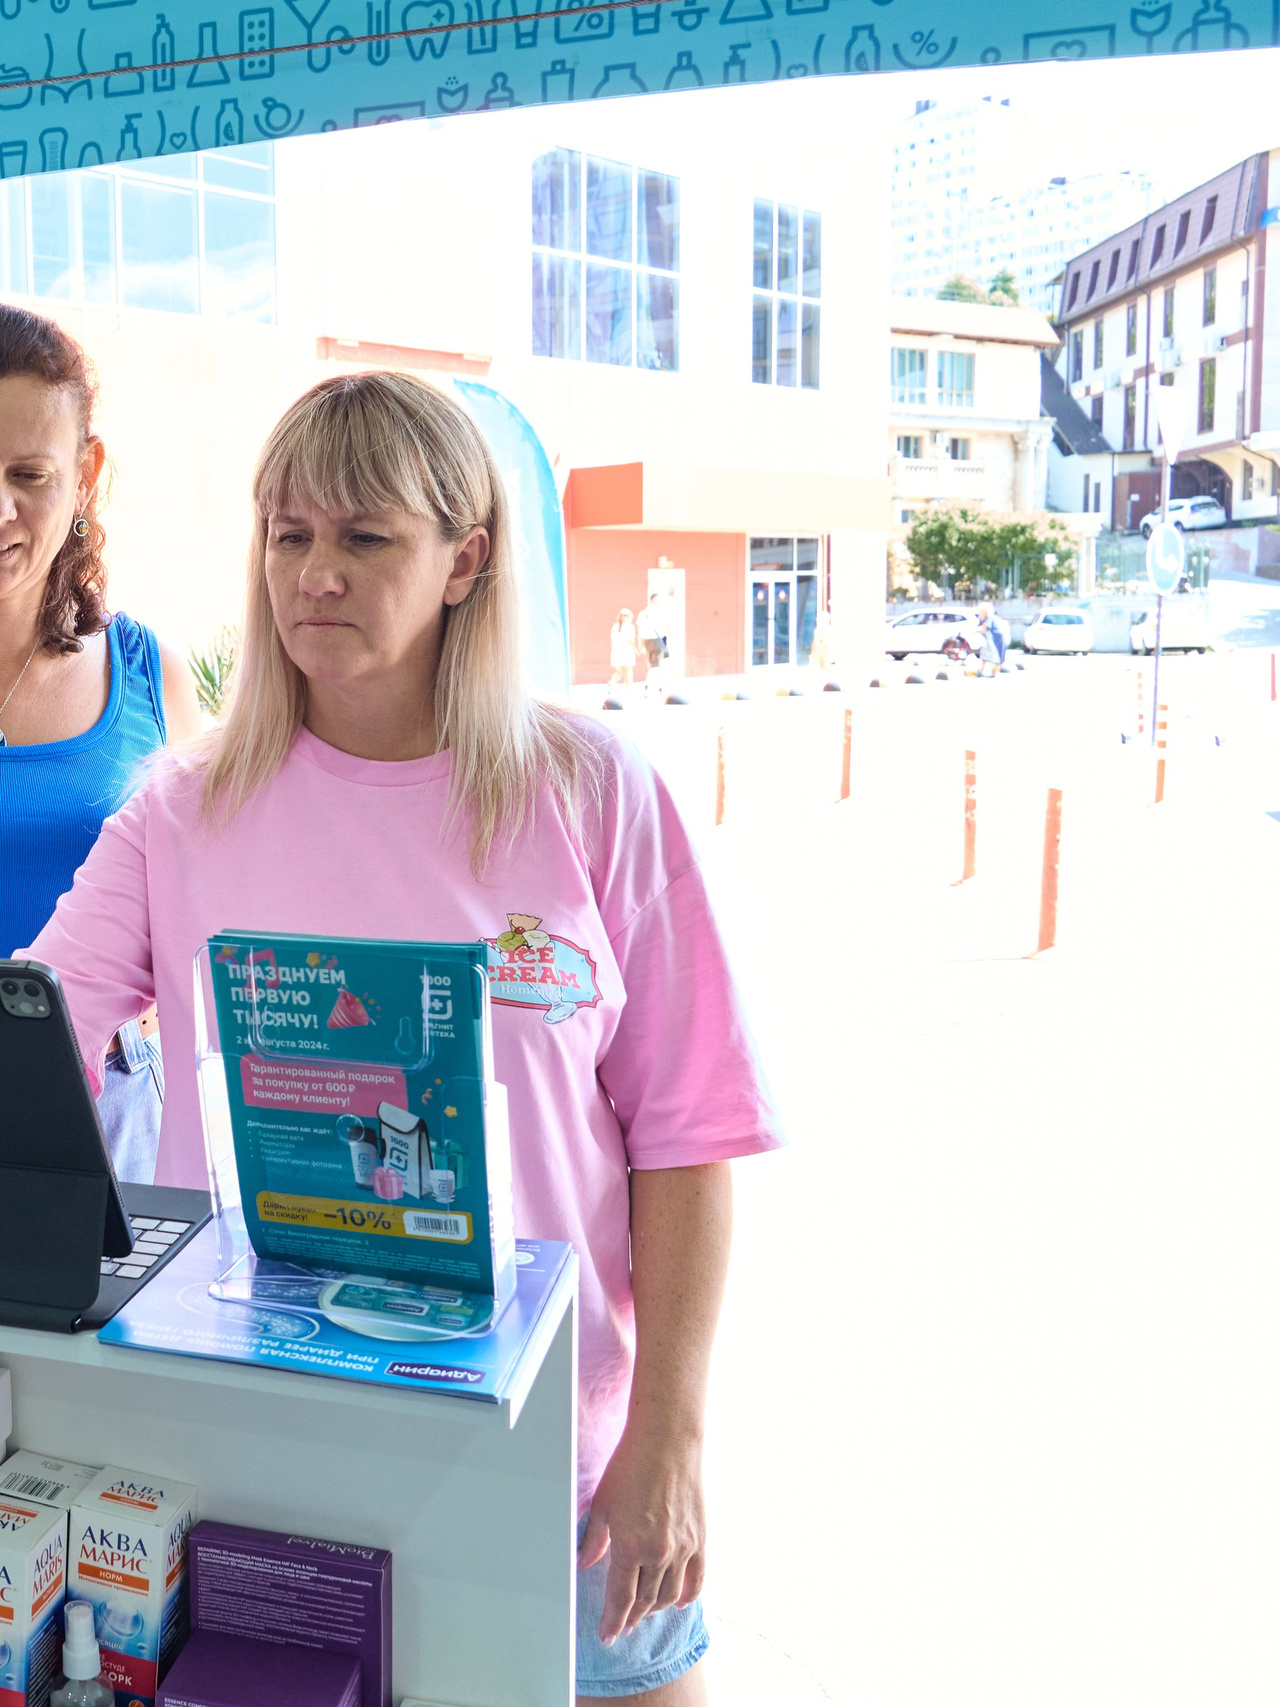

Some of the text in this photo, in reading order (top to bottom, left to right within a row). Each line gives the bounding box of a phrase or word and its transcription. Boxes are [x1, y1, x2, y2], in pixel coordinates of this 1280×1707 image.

[506, 946, 555, 965] ICE
[228, 964, 346, 985] ПРАЗДНУЕМ
[487, 965, 581, 989] CREAM
[231, 987, 310, 1006] ПЕРВУЮ
[233, 1009, 319, 1029] ТЫСЯЧУ!
[250, 1063, 396, 1084] Гарантированный подарок
[266, 1079, 309, 1092] покупку
[312, 1083, 323, 1091] от
[253, 1090, 351, 1107] каждому клиенту!
[390, 1135, 410, 1150] 1000
[393, 1364, 481, 1382] Адиарин
[107, 1486, 160, 1503] МАРИС
[112, 1480, 166, 1497] АКВА
[81, 1525, 148, 1557] АКВА
[33, 1534, 62, 1579] AQUA
[80, 1544, 147, 1574] МАРИС
[32, 1555, 63, 1600] MARIS
[99, 1570, 123, 1583] НОРМ
